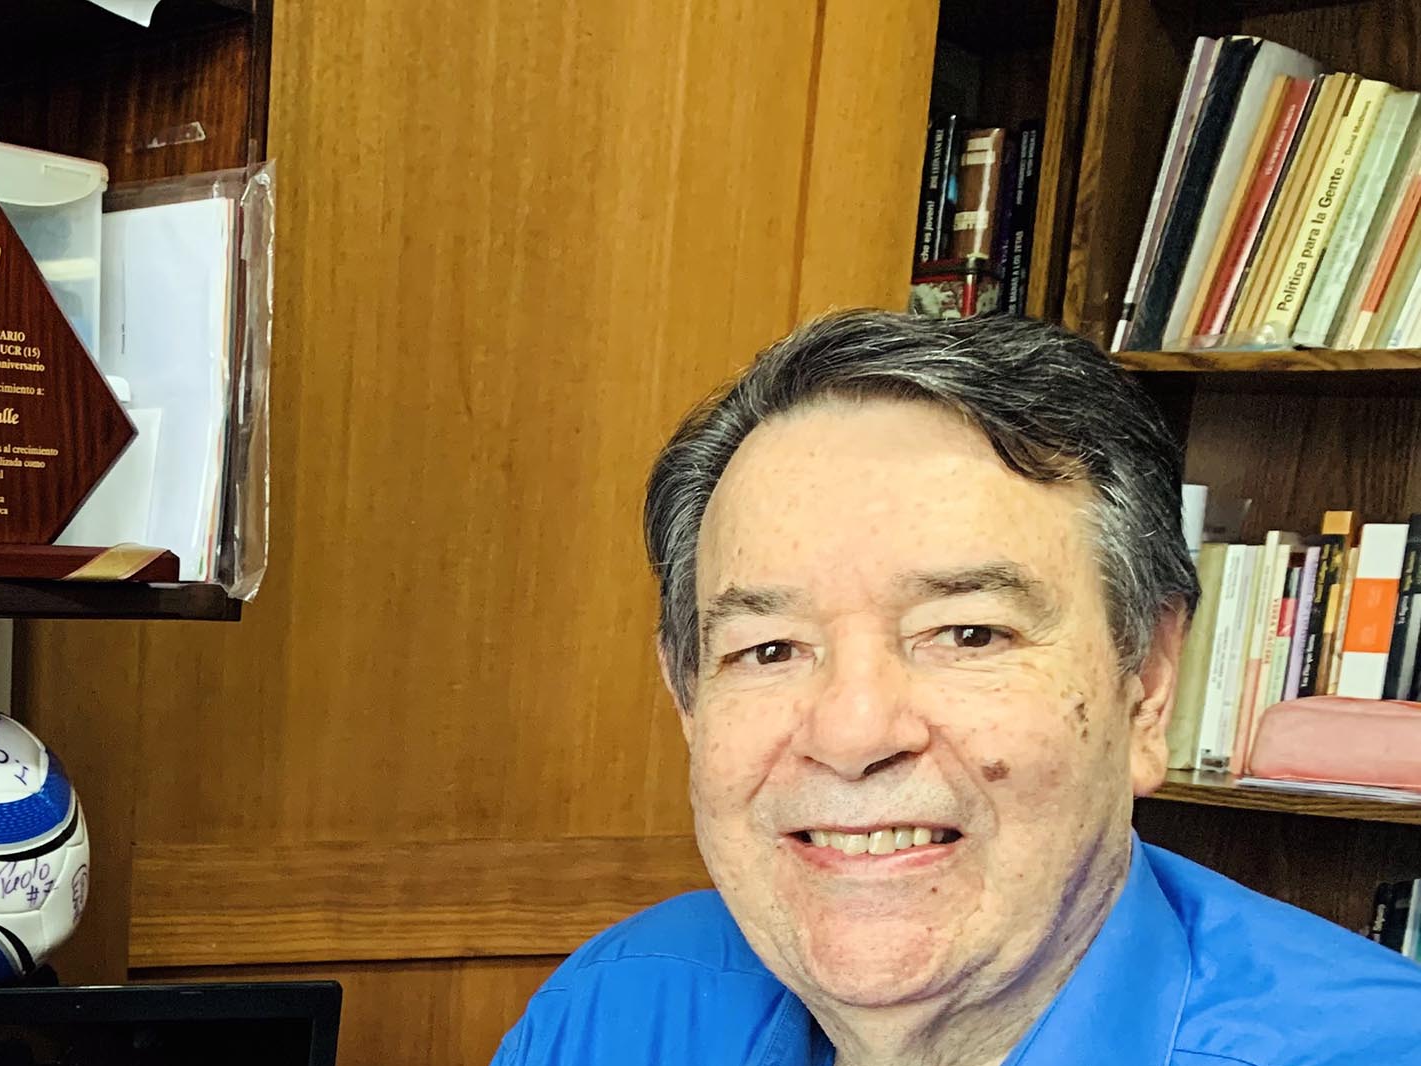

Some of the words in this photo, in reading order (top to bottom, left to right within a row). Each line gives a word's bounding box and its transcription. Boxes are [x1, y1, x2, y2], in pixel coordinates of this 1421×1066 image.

[1319, 168, 1344, 208] Gente
[1312, 213, 1327, 228] la
[1302, 228, 1320, 258] para
[0, 344, 21, 356] UCR
[24, 347, 40, 359] (15)
[4, 444, 11, 453] al
[13, 445, 58, 456] crecimiento
[24, 460, 45, 468] como
